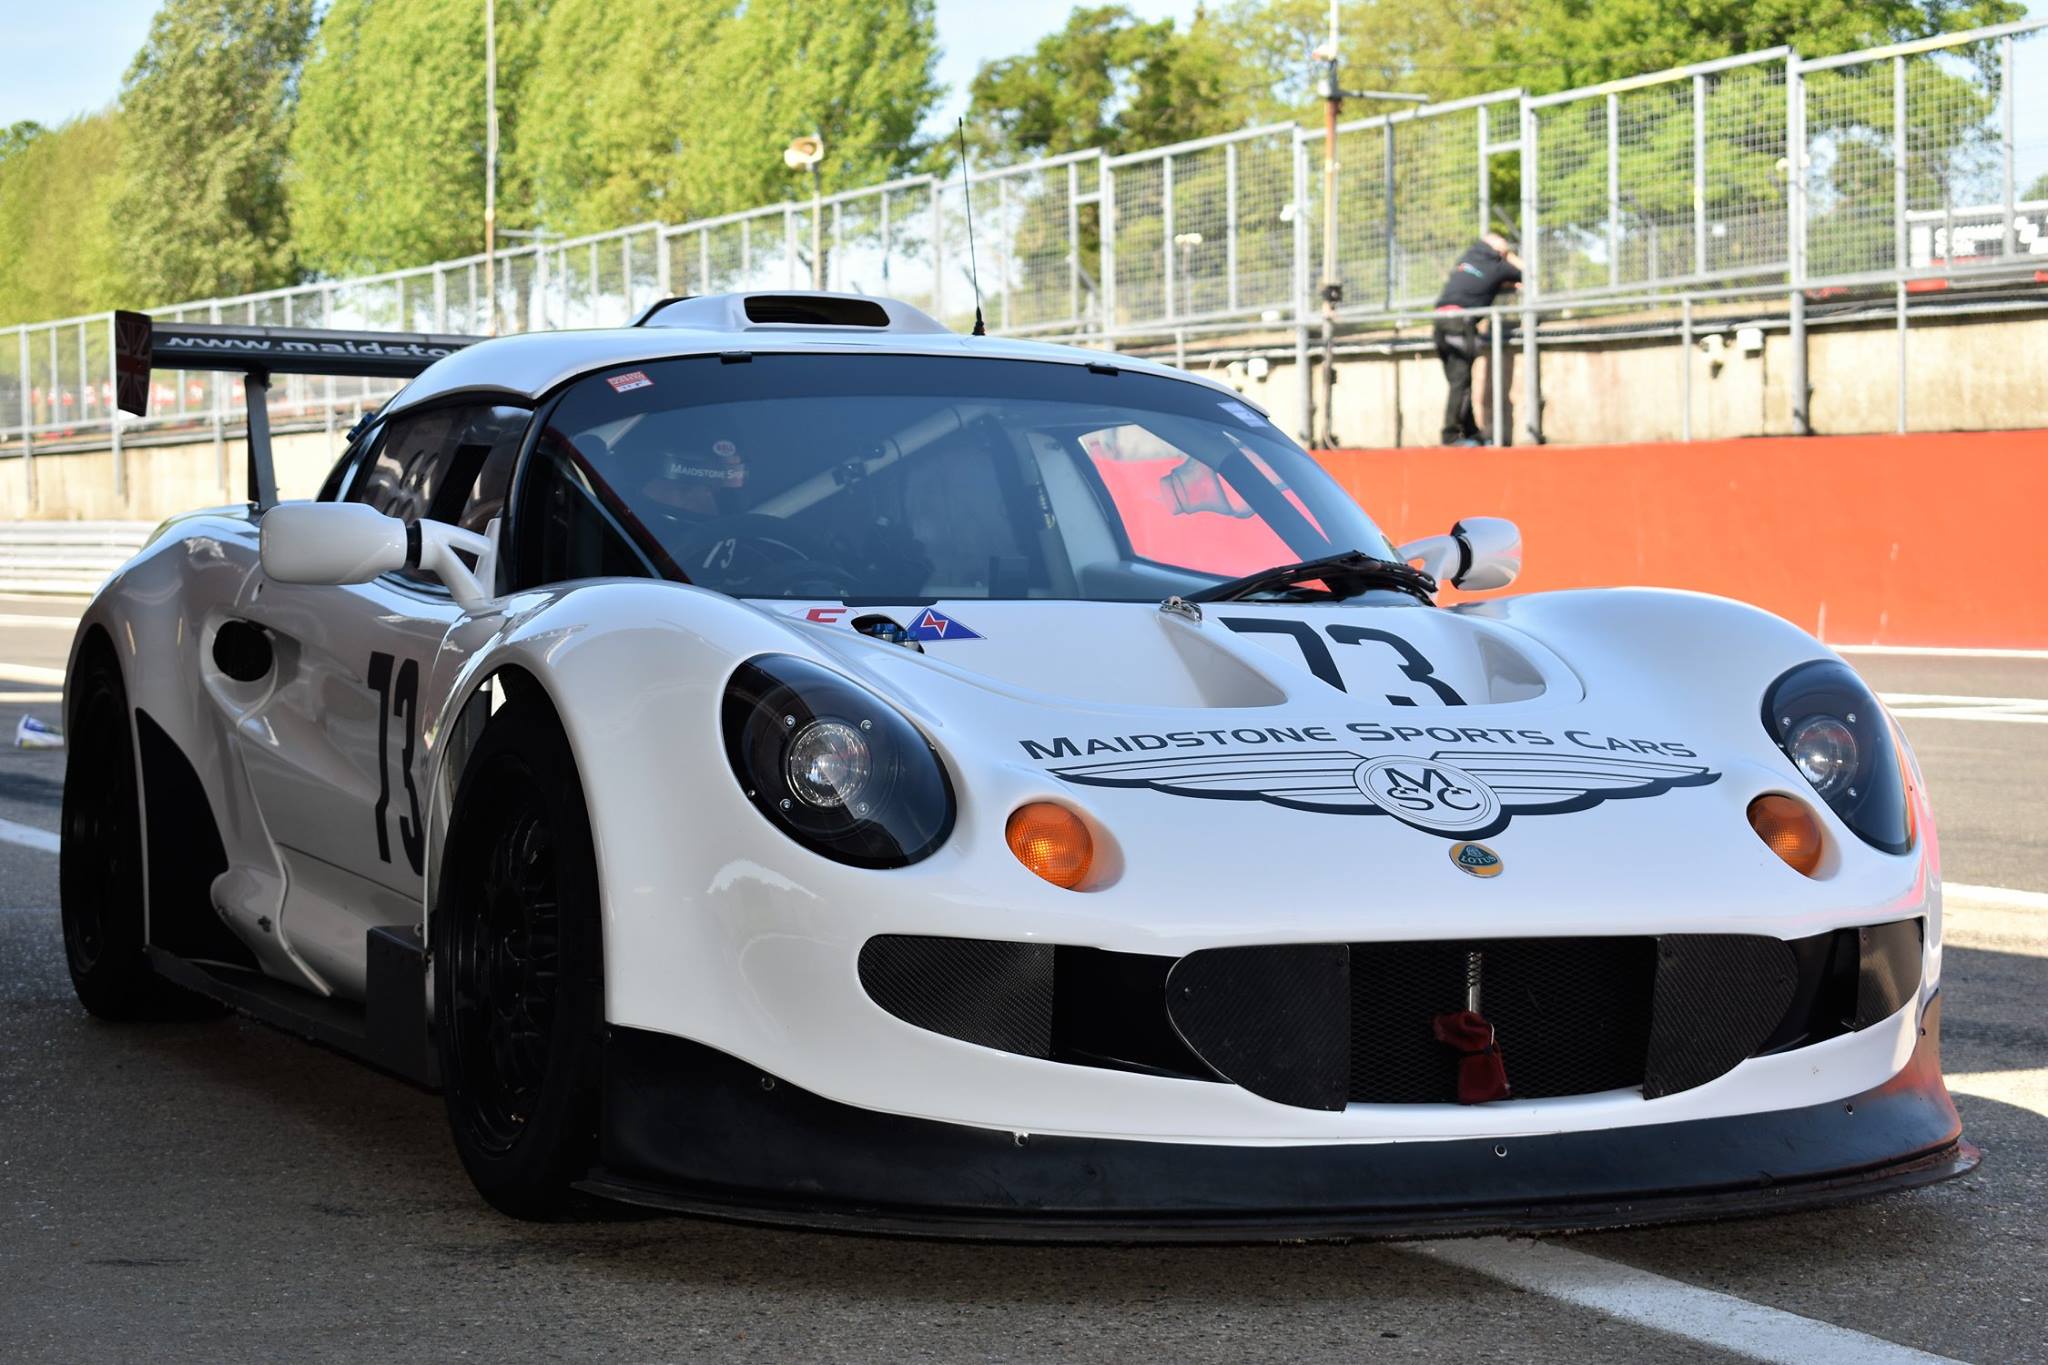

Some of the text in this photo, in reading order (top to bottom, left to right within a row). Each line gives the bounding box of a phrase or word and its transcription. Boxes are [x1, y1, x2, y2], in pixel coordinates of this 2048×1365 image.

[167, 336, 461, 358] www.maidsto
[1217, 616, 1469, 707] 73
[1019, 722, 1697, 760] MAIDSTONE SPORTS CARS
[367, 650, 425, 878] 73
[1461, 855, 1496, 864] LOTUS
